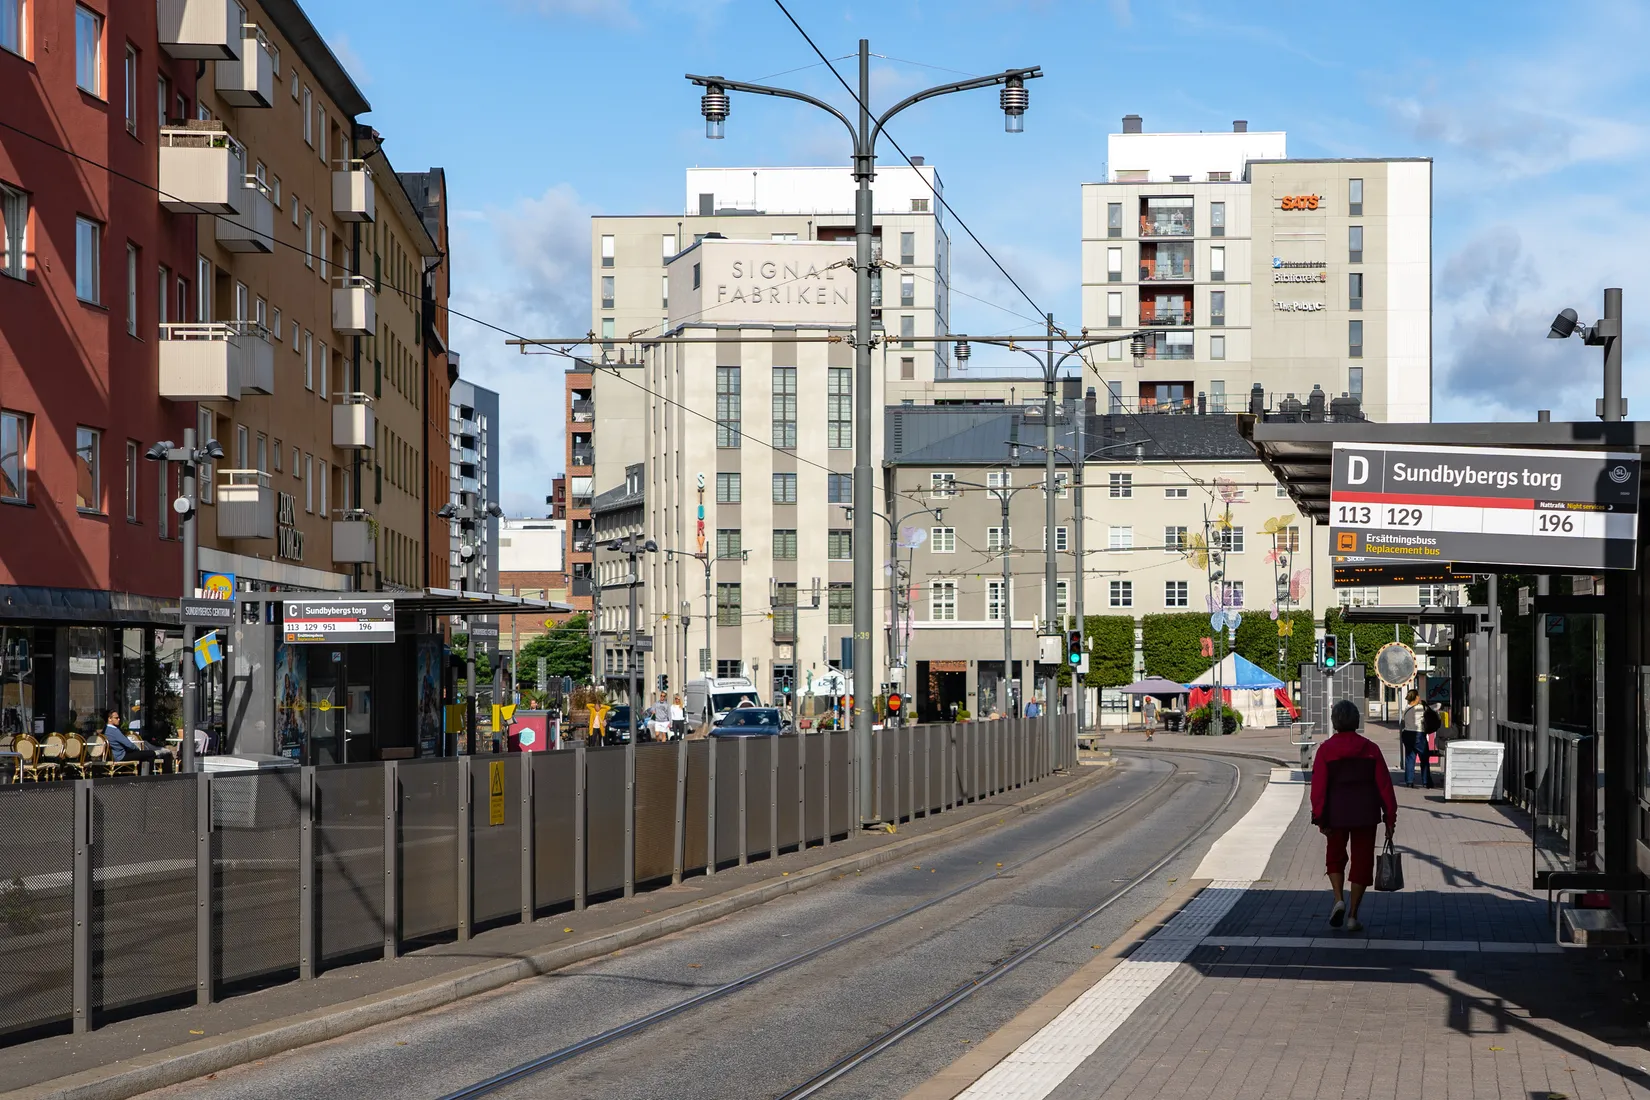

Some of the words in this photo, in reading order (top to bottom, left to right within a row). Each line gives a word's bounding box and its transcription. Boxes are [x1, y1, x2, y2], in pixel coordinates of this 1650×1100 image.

[1281, 195, 1319, 211] SATS
[731, 260, 834, 280] SIGNAL
[1274, 272, 1317, 283] Bibliotek
[717, 284, 849, 305] FABRIKEN
[1347, 455, 1370, 485] D
[1392, 462, 1519, 489] Sundbybergs
[1521, 468, 1562, 491] torg
[696, 472, 705, 553] STORY
[1539, 501, 1566, 509] Nattrafik
[1566, 502, 1583, 510] Night
[1338, 505, 1371, 524] 113
[1387, 508, 1423, 526] 129
[1538, 514, 1574, 532] 196
[1366, 533, 1437, 546] Ersättningsbuss
[1365, 543, 1423, 556] Replacement
[1424, 546, 1440, 556] bus
[289, 605, 298, 617] C
[305, 606, 351, 616] Sundbybergs
[352, 606, 367, 616] torg
[287, 623, 300, 631] 113
[304, 623, 318, 631] 129
[322, 623, 336, 631] 951
[359, 623, 372, 631] 196
